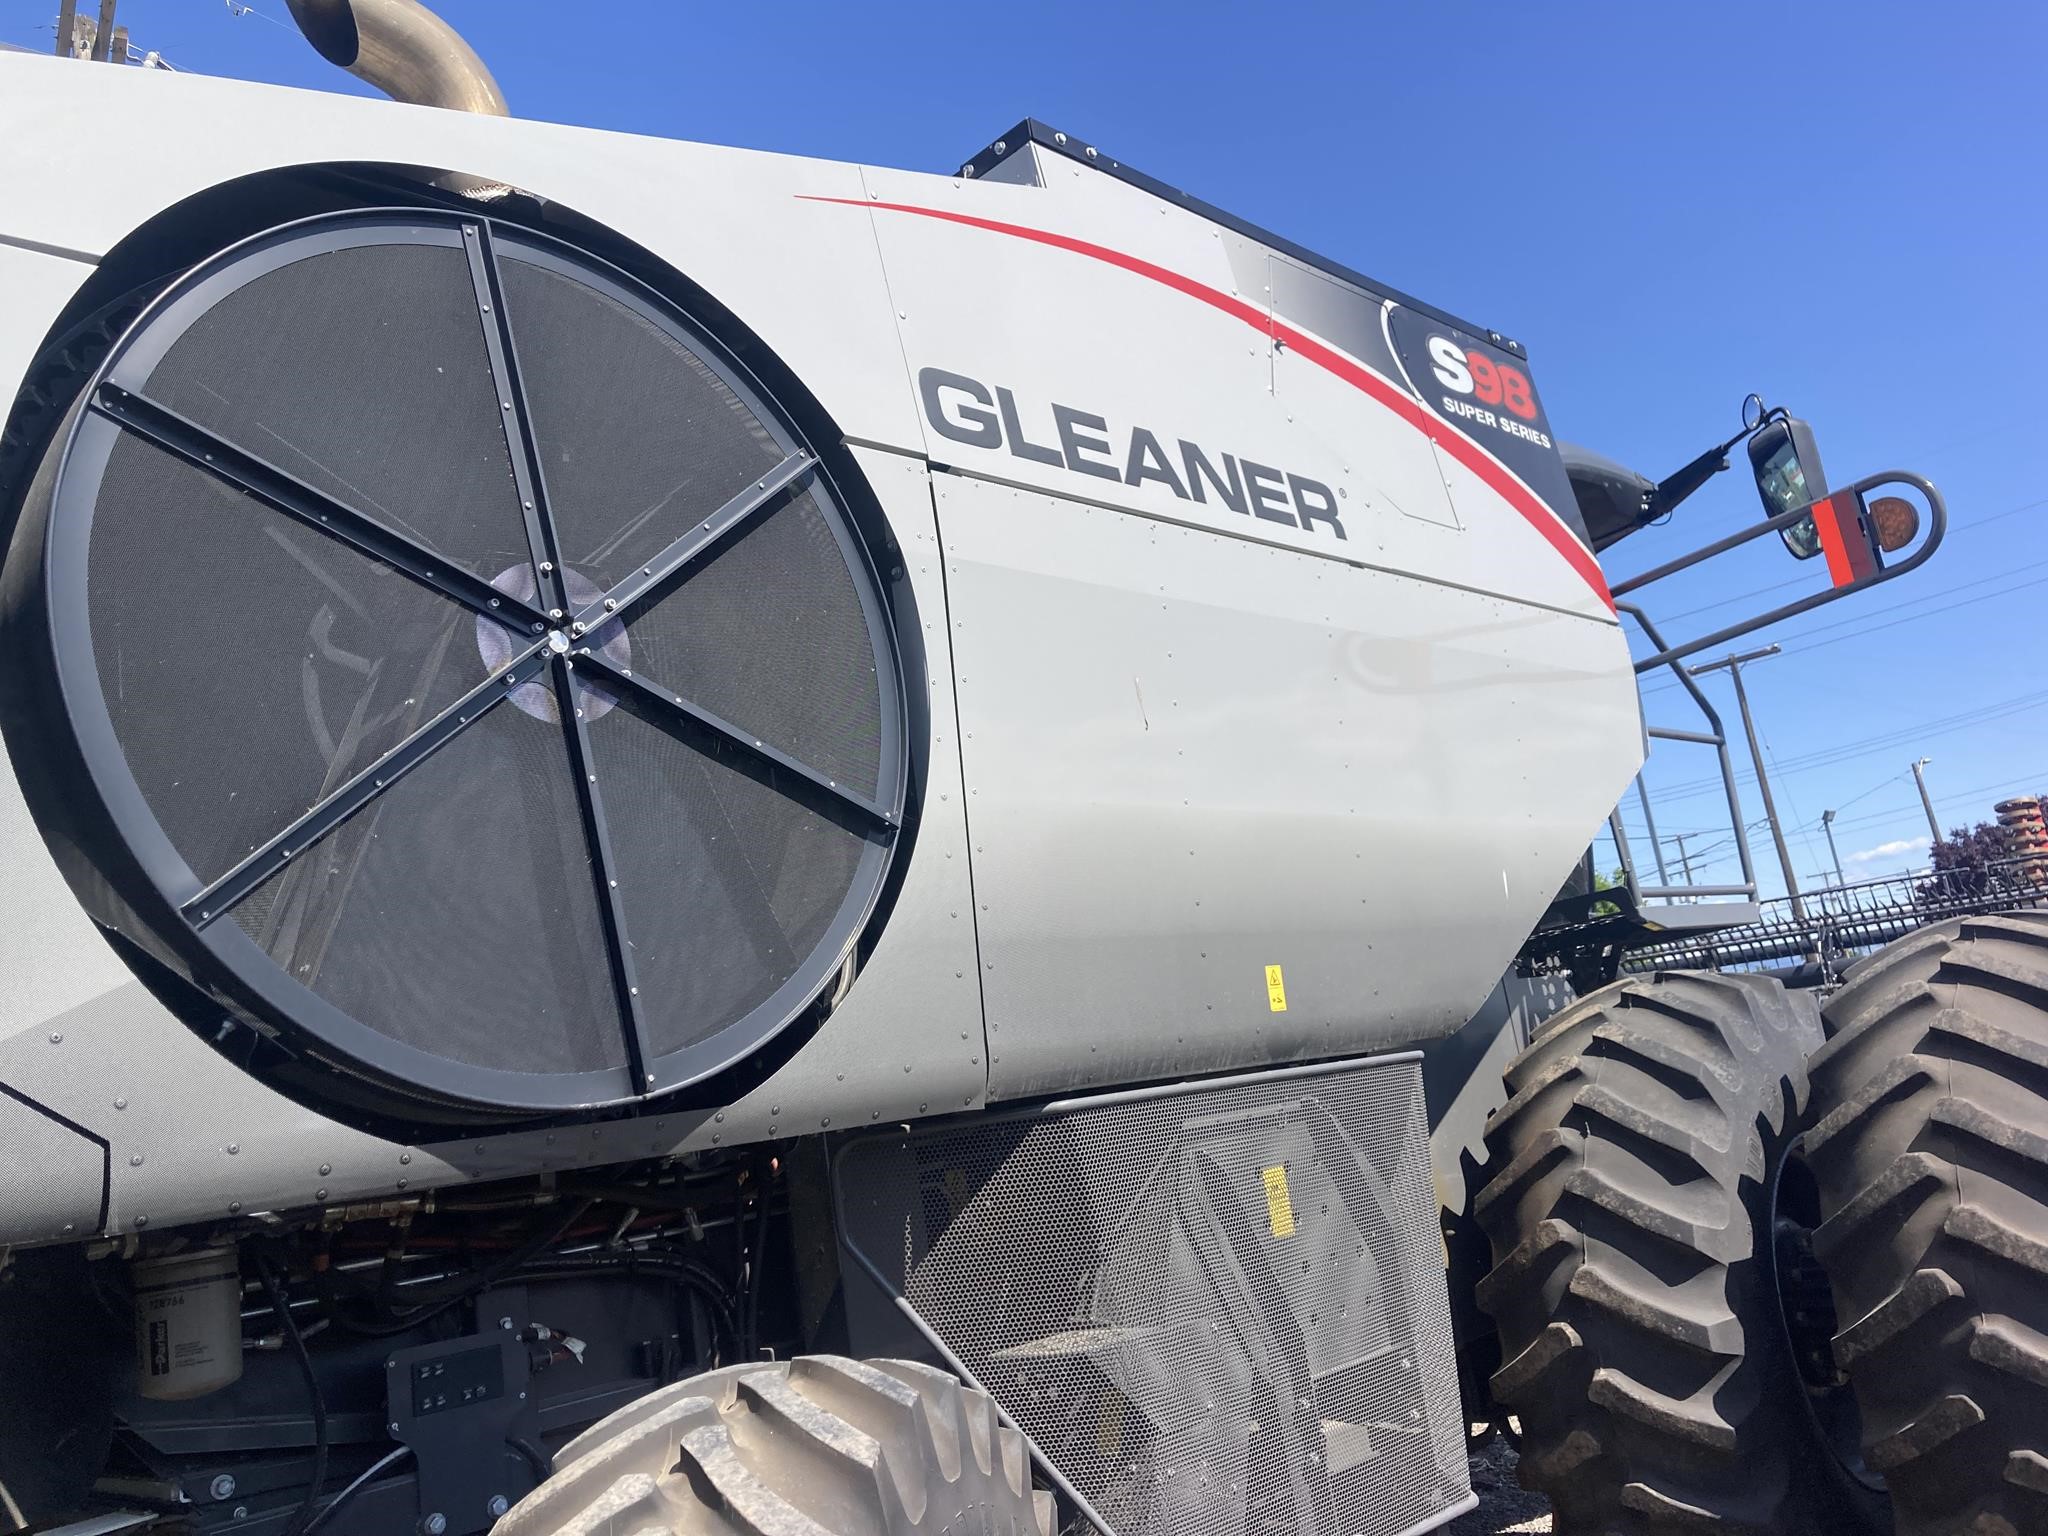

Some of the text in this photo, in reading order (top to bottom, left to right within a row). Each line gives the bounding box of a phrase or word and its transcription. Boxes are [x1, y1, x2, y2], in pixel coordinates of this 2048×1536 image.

[1429, 336, 1537, 420] S98
[918, 366, 1347, 540] GLEANER
[1442, 396, 1551, 449] SUPER SERIES
